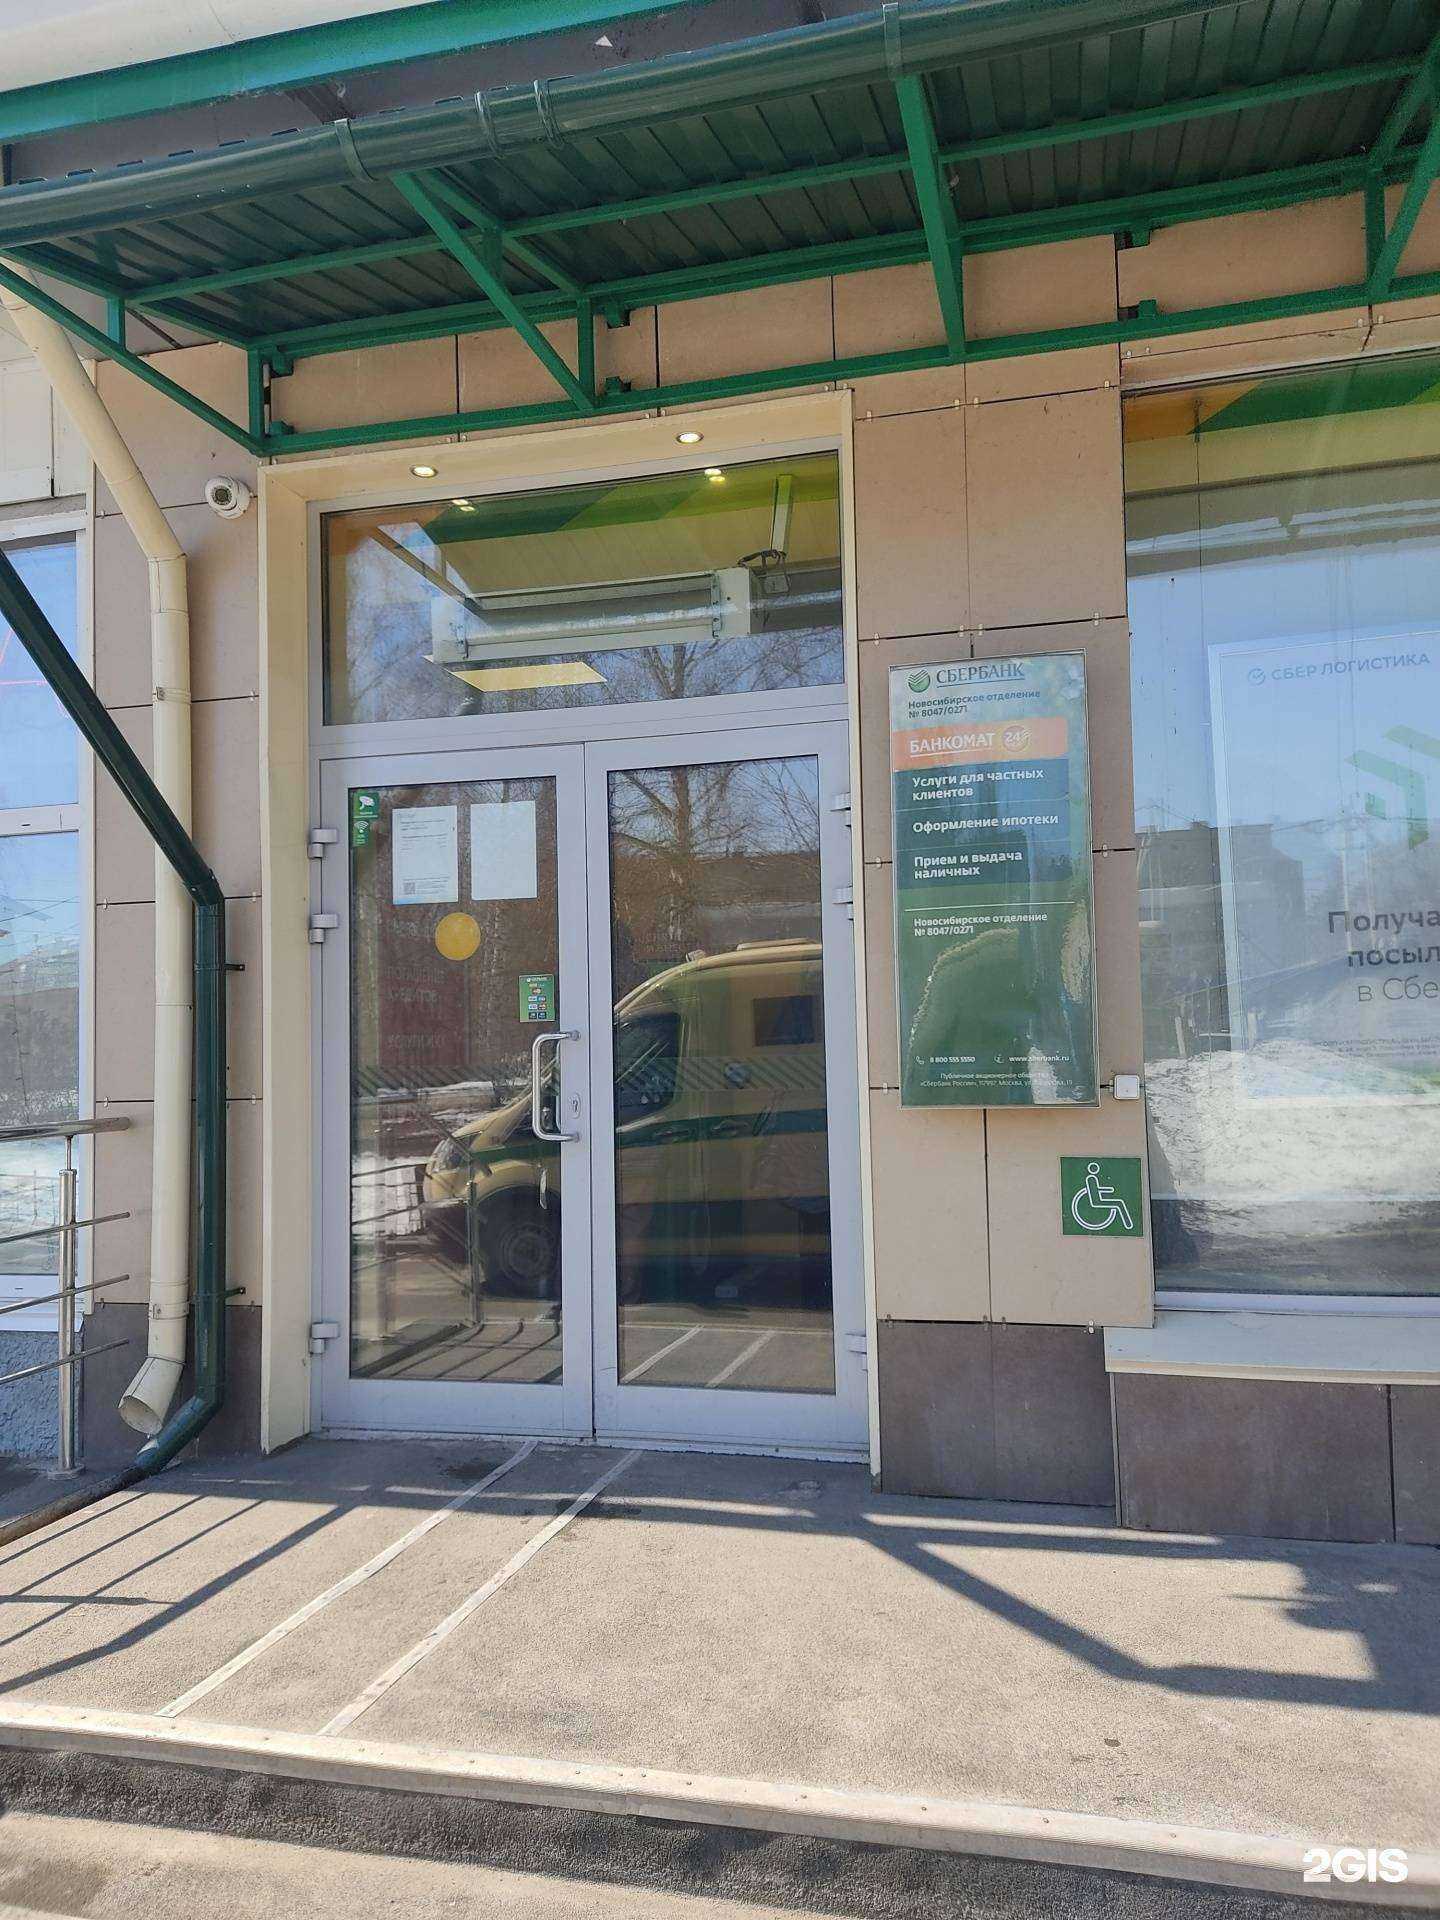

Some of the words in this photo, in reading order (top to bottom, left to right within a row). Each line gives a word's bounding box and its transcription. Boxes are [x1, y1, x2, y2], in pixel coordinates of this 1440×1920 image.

[936, 662, 1026, 685] СБЕРБАНК
[1271, 664, 1318, 681] СБЕР
[1320, 653, 1431, 676] ЛОГИСТИКА
[908, 694, 985, 709] Новосибирское
[986, 690, 1041, 702] отделение
[908, 710, 919, 719] №
[921, 704, 968, 718] 8047/0271
[910, 732, 996, 754] БАНКОМАТ
[912, 775, 957, 788] Услуги
[960, 772, 984, 785] для
[987, 770, 1044, 781] частных
[912, 787, 974, 801] клиентов
[912, 817, 999, 834] Оформление
[1001, 815, 1059, 827] ипотеки
[914, 855, 957, 869] Прием
[960, 856, 969, 864] и
[971, 851, 1023, 864] выдача
[914, 867, 980, 880] наличных
[914, 915, 991, 928] Новосибирское
[992, 913, 1048, 924] отделение
[1328, 909, 1440, 936] Получа
[914, 928, 925, 937] №
[926, 926, 974, 936] 8047/0271
[1348, 946, 1440, 968] посыл
[1357, 985, 1372, 1002] в
[1383, 975, 1439, 1002] Сбе
